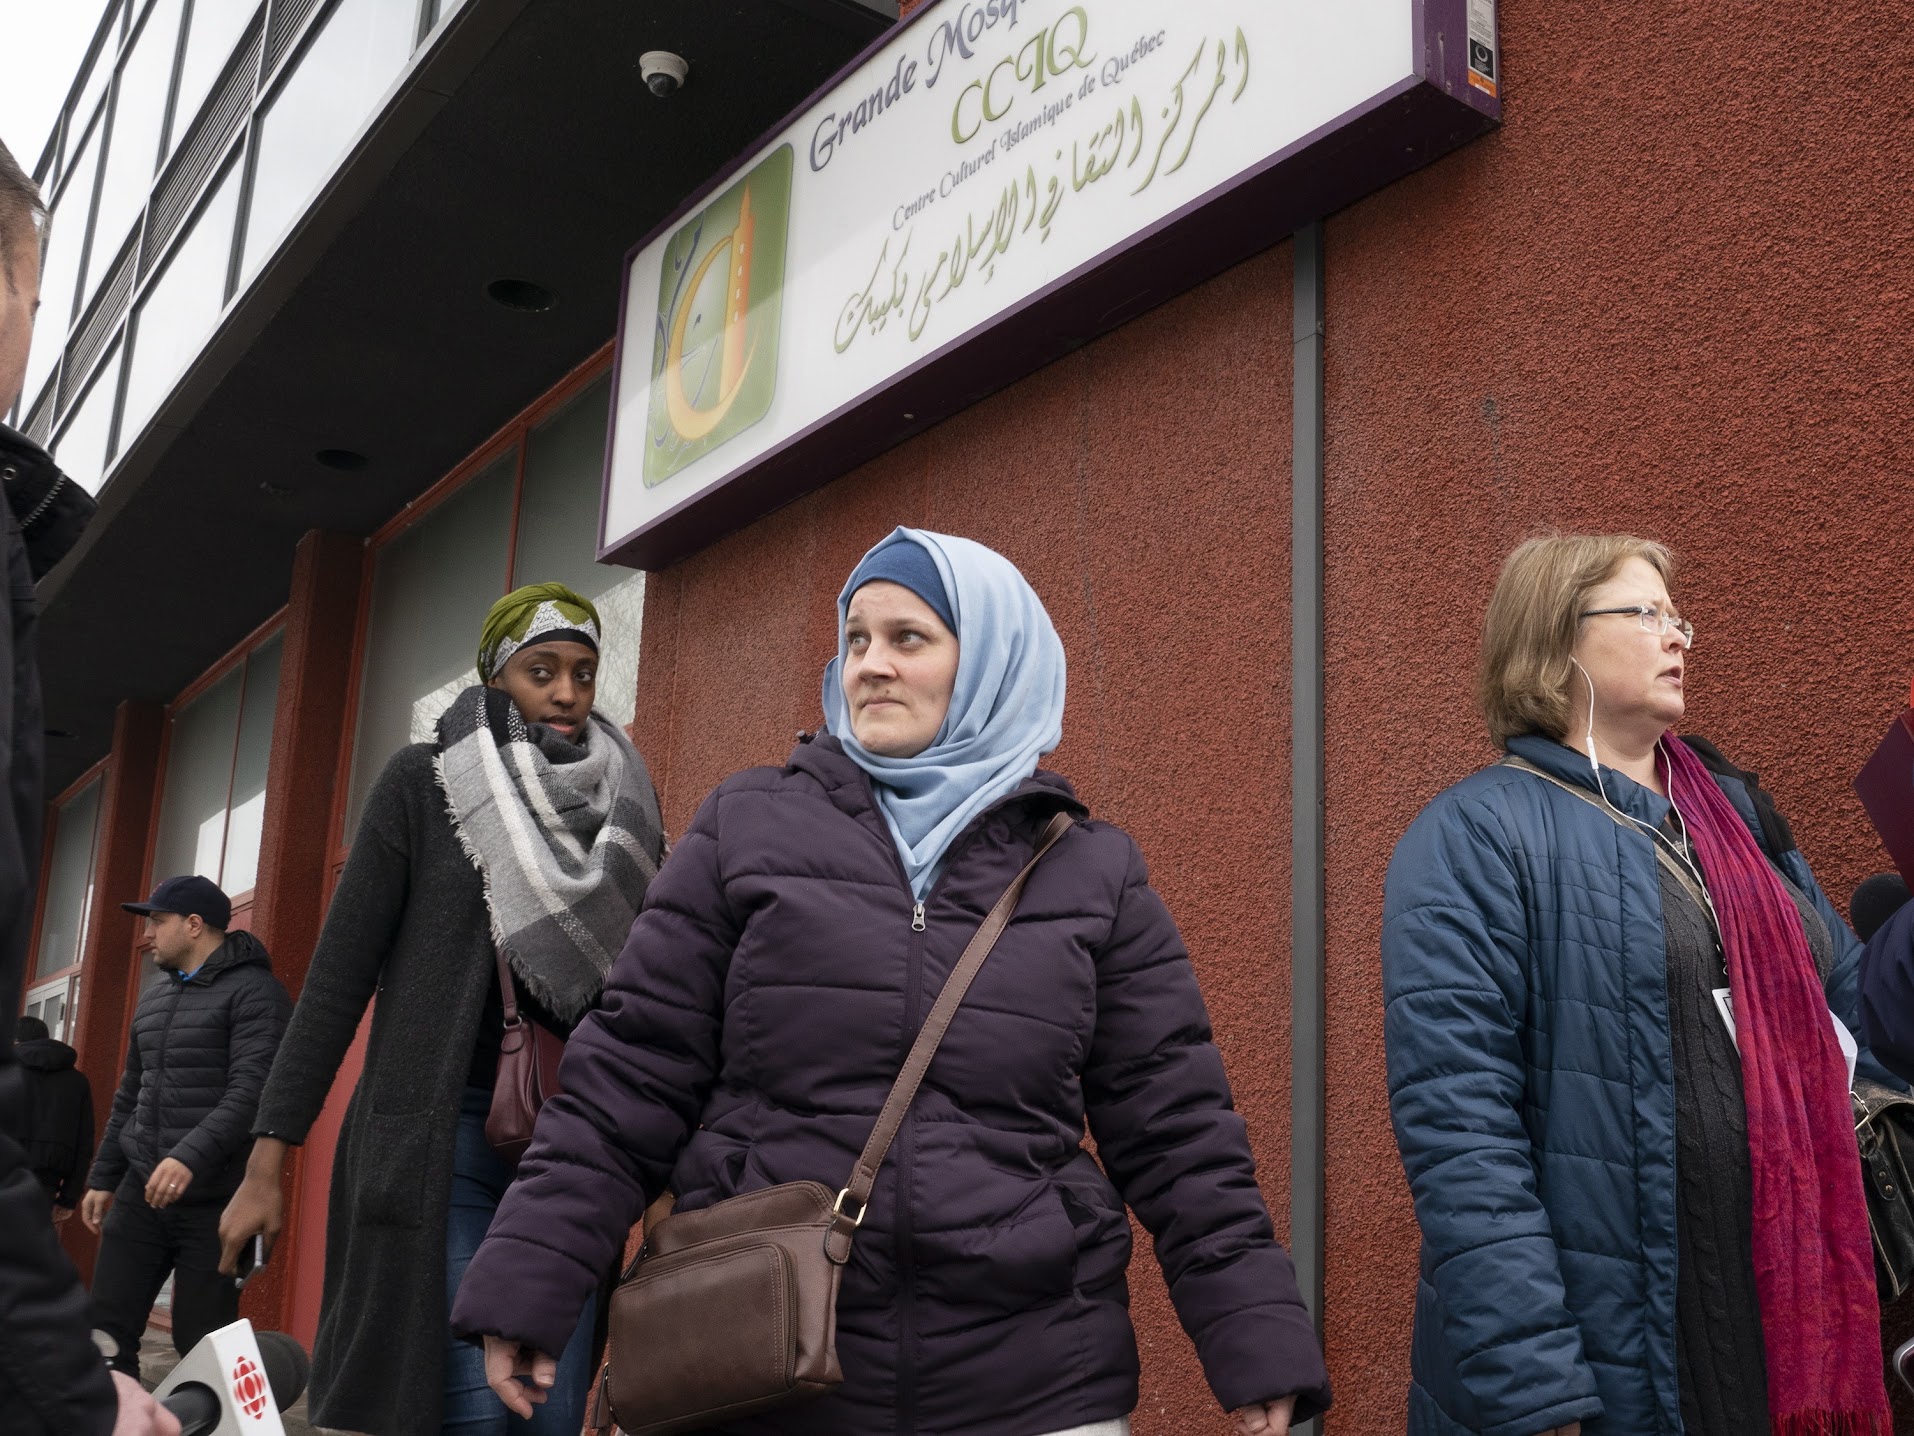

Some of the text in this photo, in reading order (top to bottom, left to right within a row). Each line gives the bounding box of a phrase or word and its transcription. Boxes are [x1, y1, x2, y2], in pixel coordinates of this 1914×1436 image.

[810, 0, 1026, 172] Grande Mosq
[892, 29, 1165, 231] Centre Culturel Islamique de Québec
[951, 3, 1098, 144] CCIQ
[1130, 25, 1249, 197] المركز
